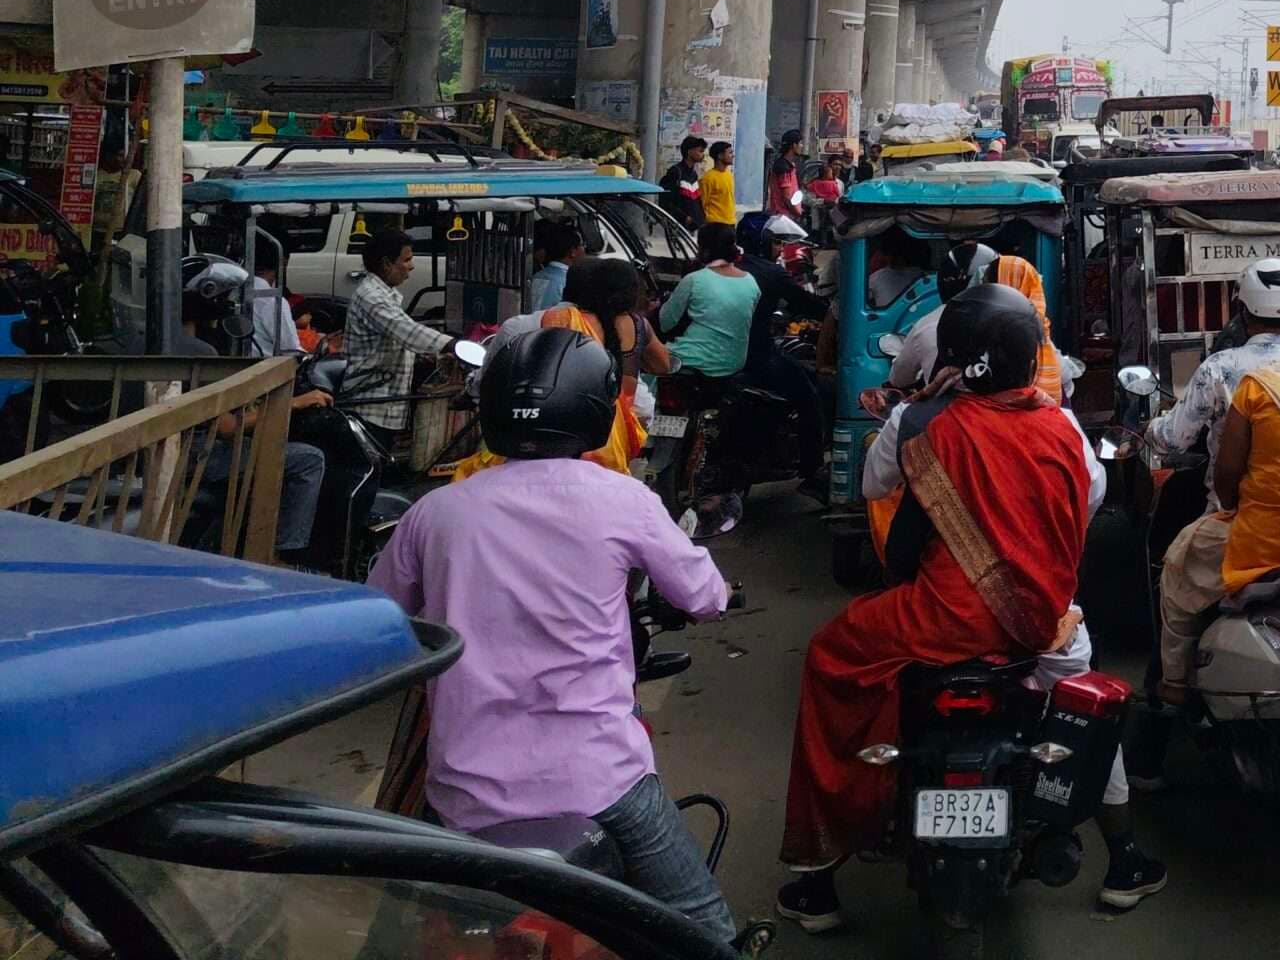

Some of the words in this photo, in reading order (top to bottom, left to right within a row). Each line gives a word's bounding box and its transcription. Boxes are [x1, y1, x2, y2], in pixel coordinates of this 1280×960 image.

[489, 47, 507, 59] TAJ
[510, 47, 551, 60] HEALTH
[554, 47, 577, 60] CAR
[1218, 181, 1270, 193] TERRA
[1200, 245, 1260, 260] TERRA
[512, 408, 540, 419] TVS
[1036, 771, 1073, 801] Steelbird
[934, 793, 996, 813] BR37A
[932, 815, 996, 835] F7194
